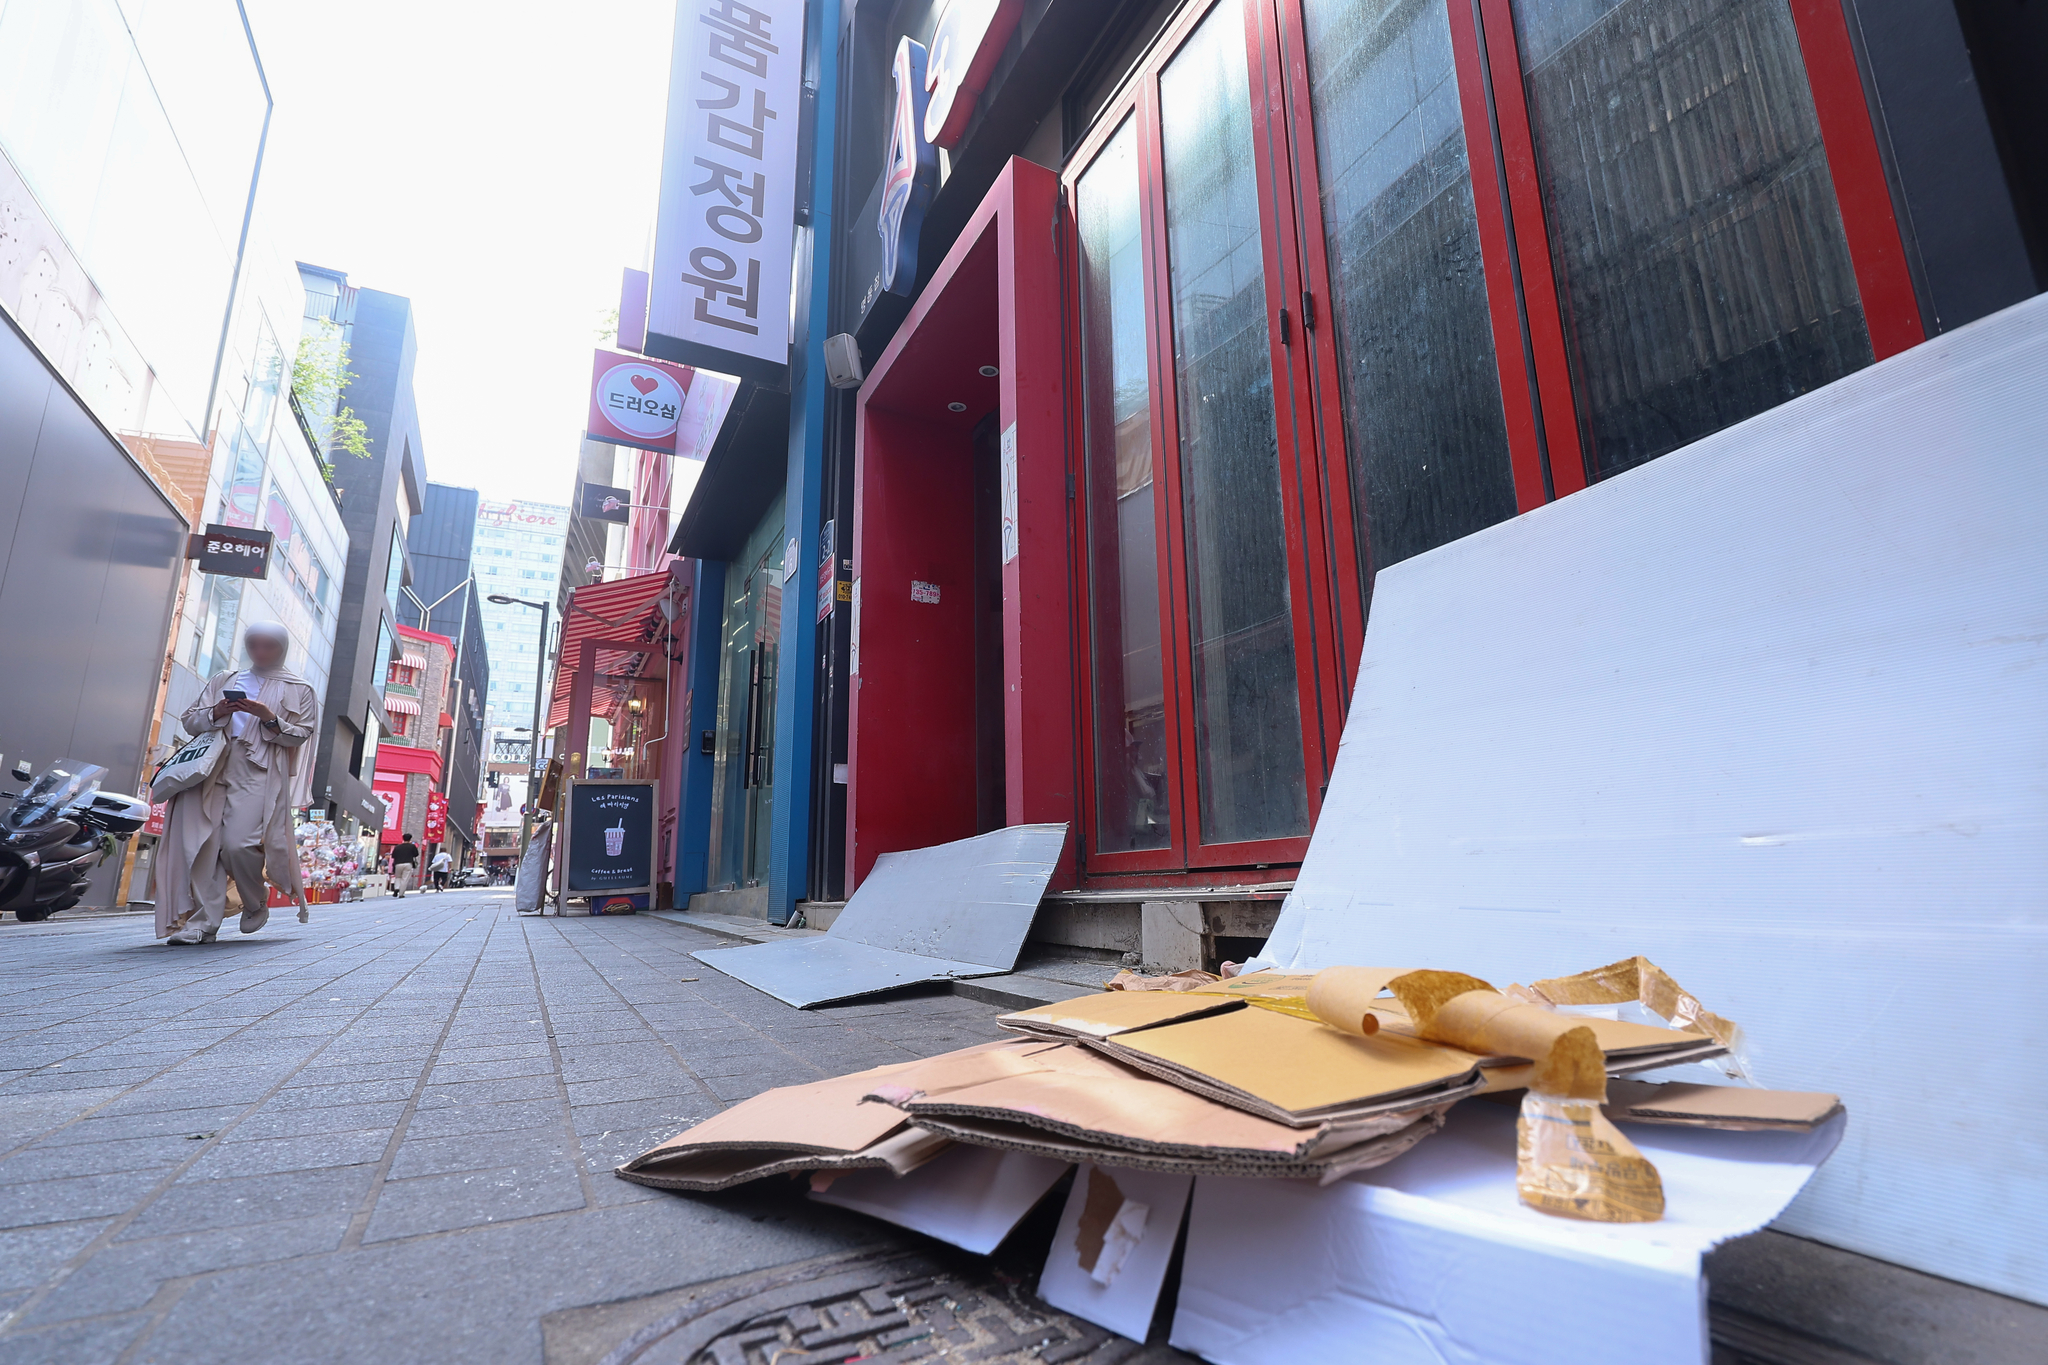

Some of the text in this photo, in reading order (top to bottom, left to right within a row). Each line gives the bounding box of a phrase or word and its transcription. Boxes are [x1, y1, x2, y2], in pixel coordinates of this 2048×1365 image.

[681, 0, 779, 336] 품감정원
[608, 392, 677, 420] 드러오삼
[206, 540, 265, 559] 준오헤어
[606, 793, 639, 803] Parisiens
